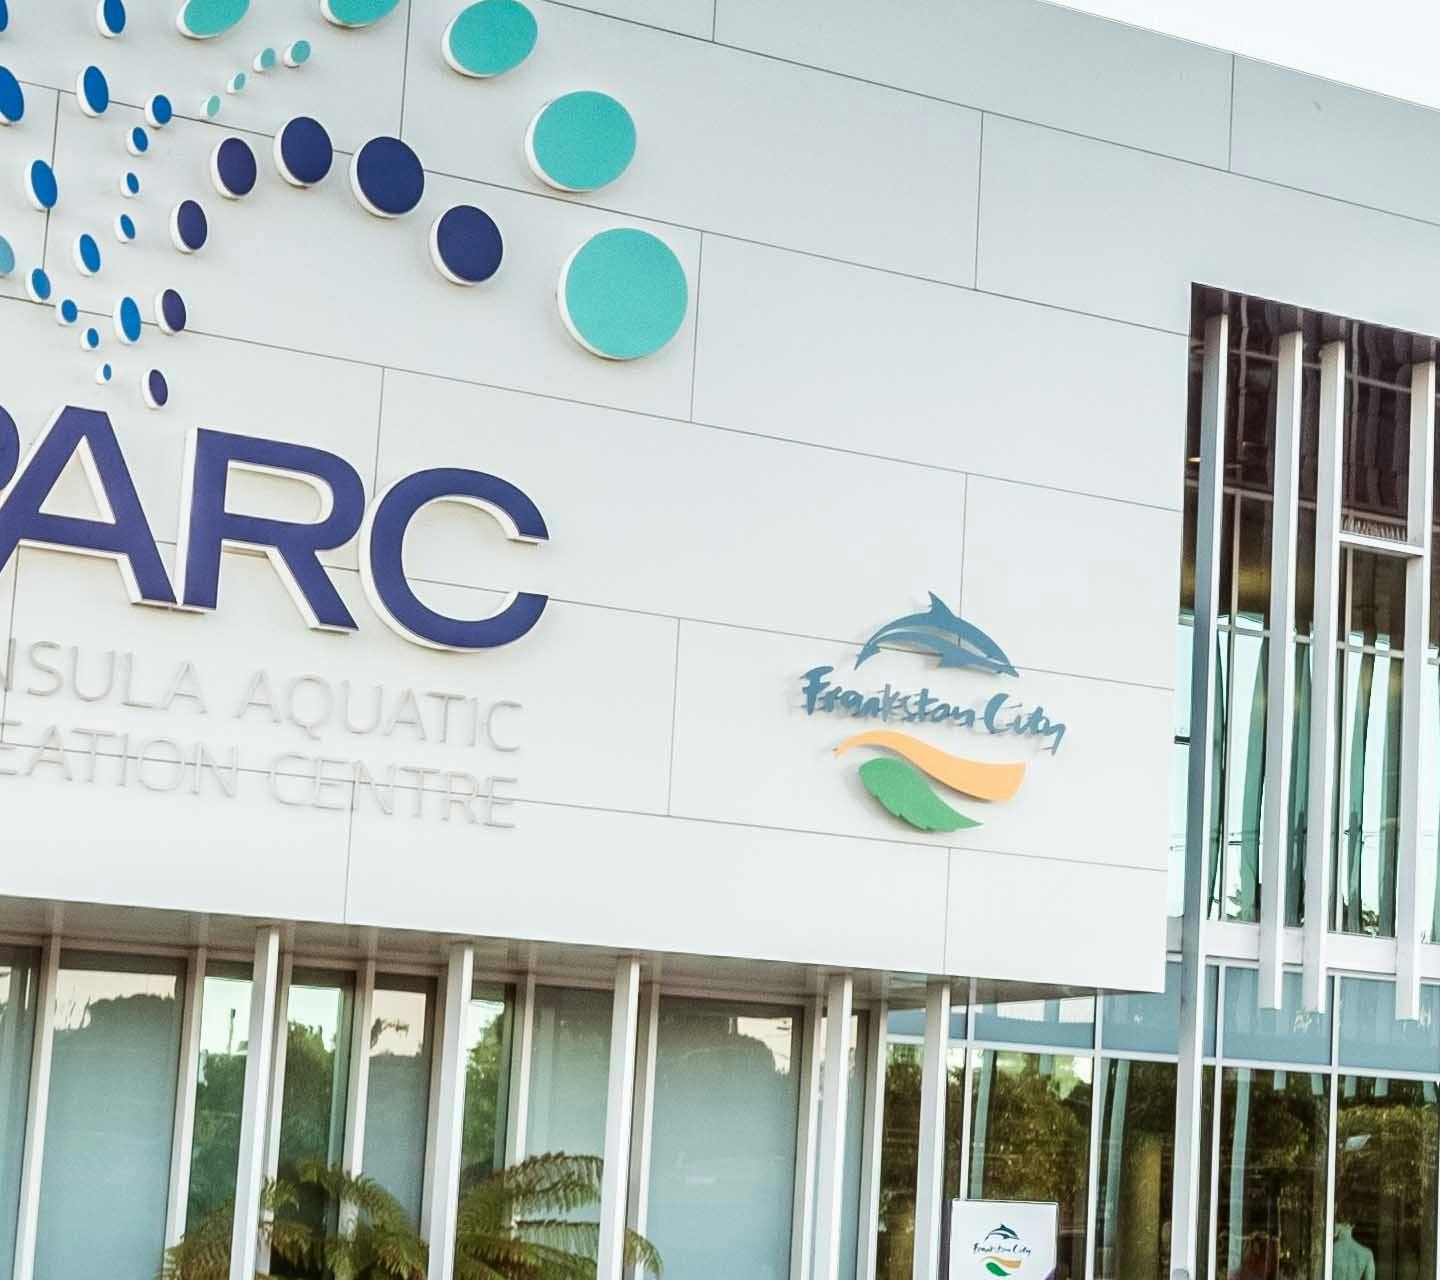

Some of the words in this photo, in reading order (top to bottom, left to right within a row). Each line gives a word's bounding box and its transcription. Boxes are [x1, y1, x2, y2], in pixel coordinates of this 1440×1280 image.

[235, 669, 523, 753] AQUATIC
[801, 665, 975, 727] Frankston
[982, 692, 1066, 756] City
[267, 752, 519, 829] CENTRE
